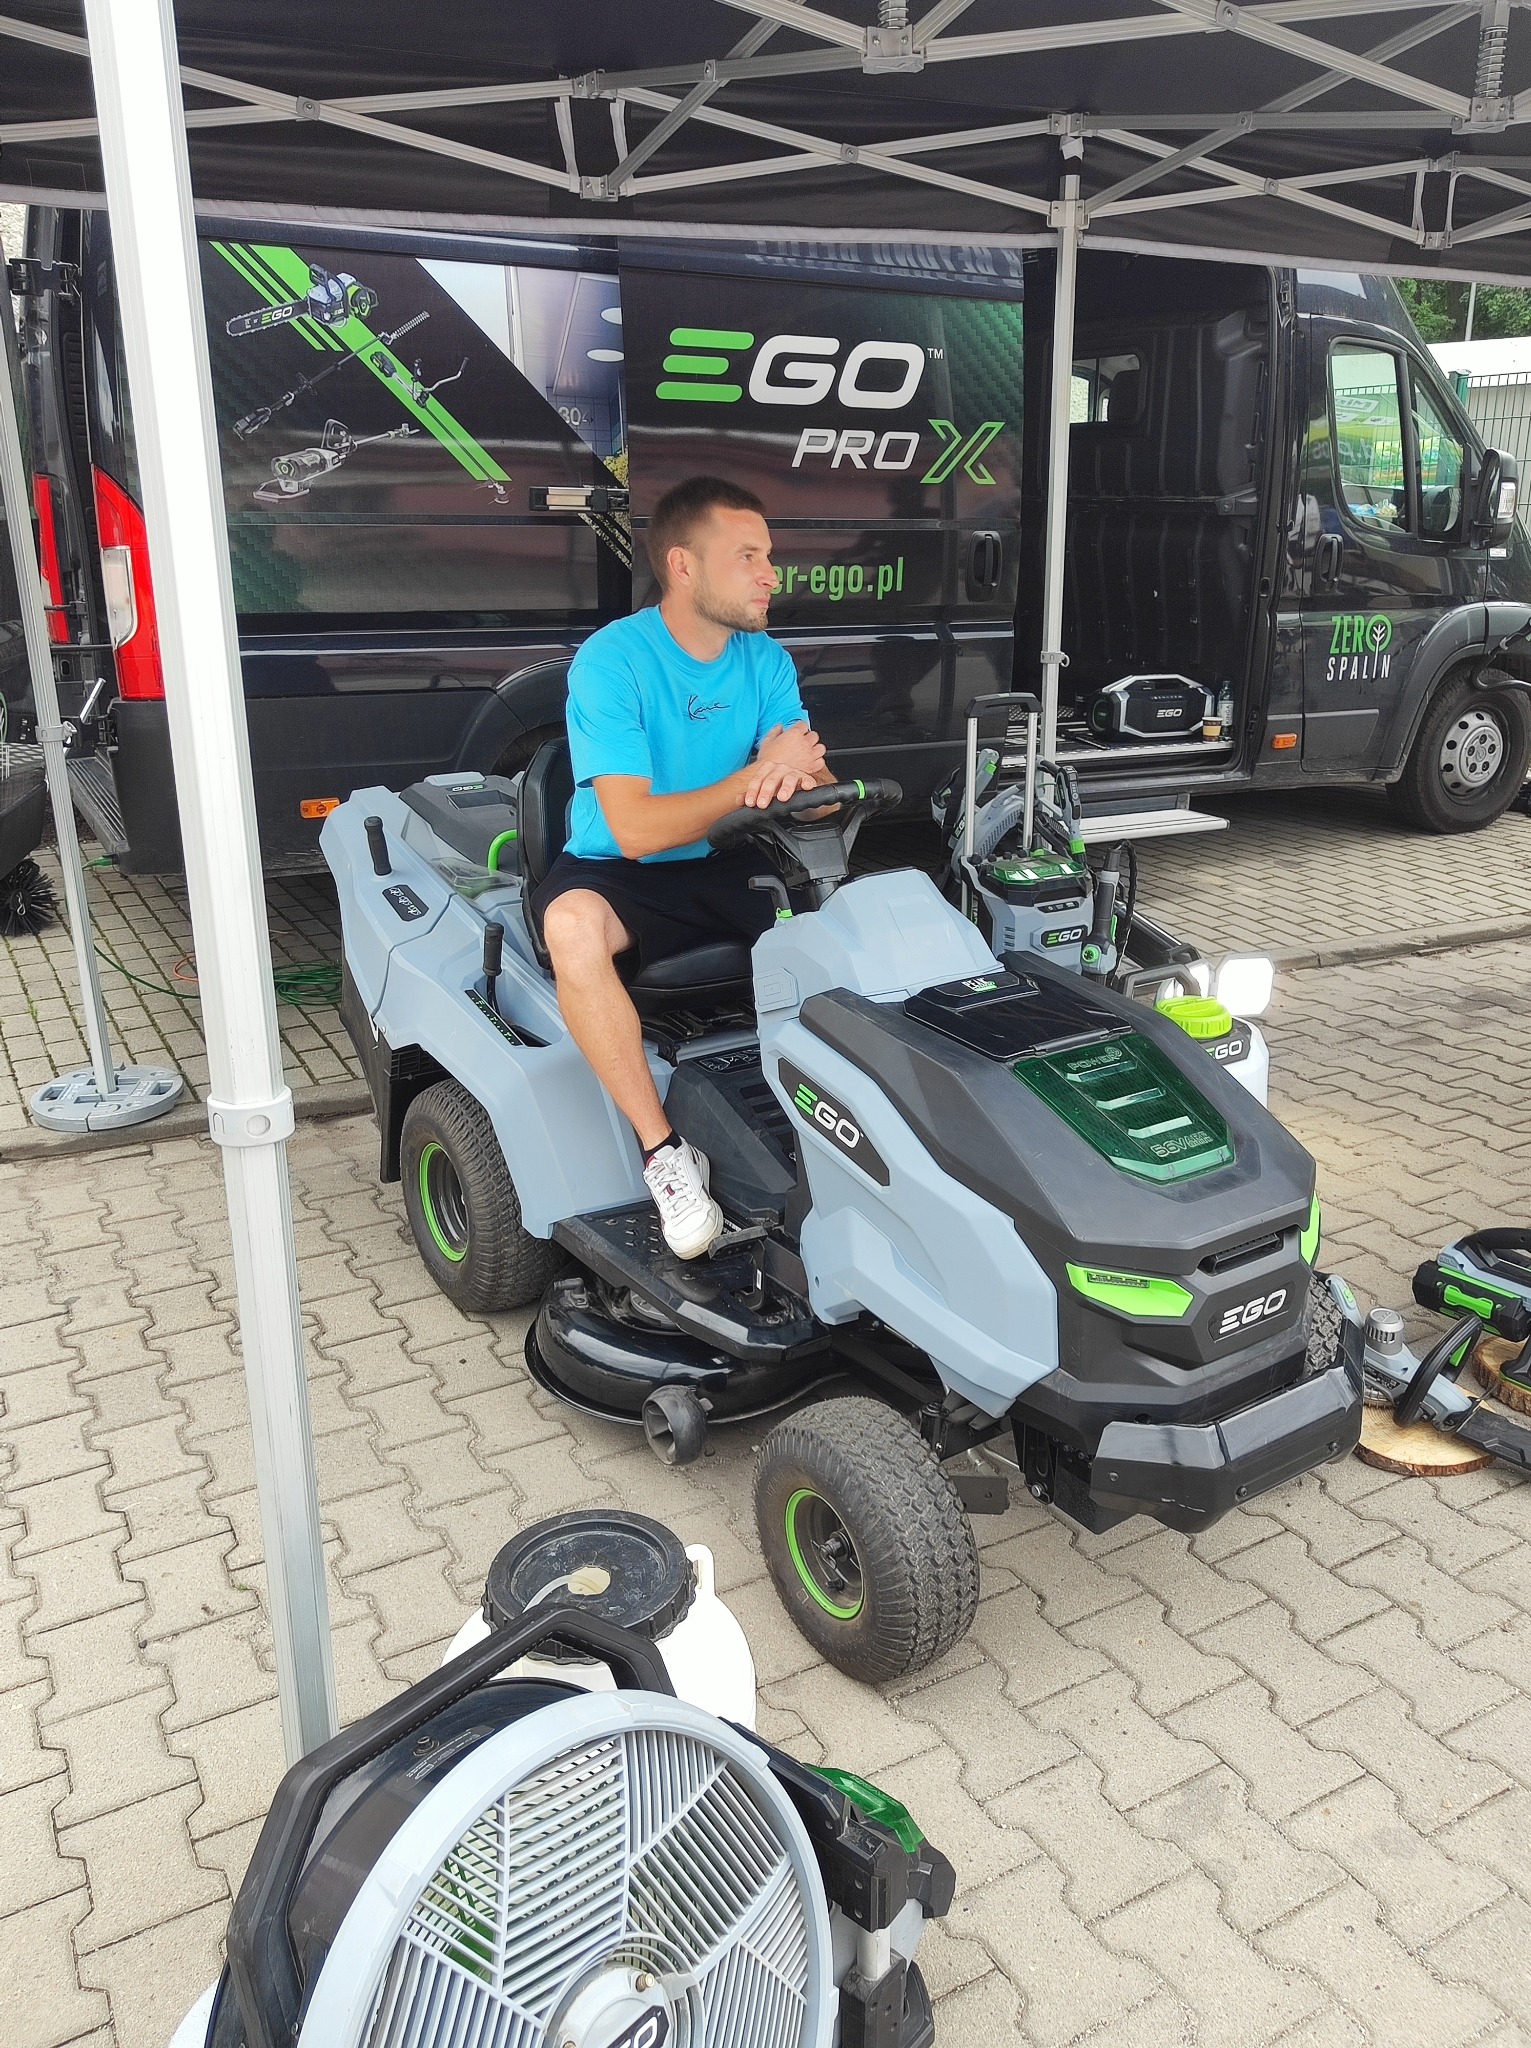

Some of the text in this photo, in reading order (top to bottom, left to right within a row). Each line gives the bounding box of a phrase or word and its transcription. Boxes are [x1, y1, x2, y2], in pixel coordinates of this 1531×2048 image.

[261, 306, 293, 324] EGO
[655, 327, 926, 410] EGO
[791, 427, 921, 471] PRO
[1329, 614, 1392, 654] ZERO
[1326, 654, 1391, 681] SPALIN
[1156, 708, 1183, 718] EGO
[1046, 928, 1083, 945] EGO
[794, 1083, 861, 1149] EGO
[1219, 1288, 1288, 1335] EGO
